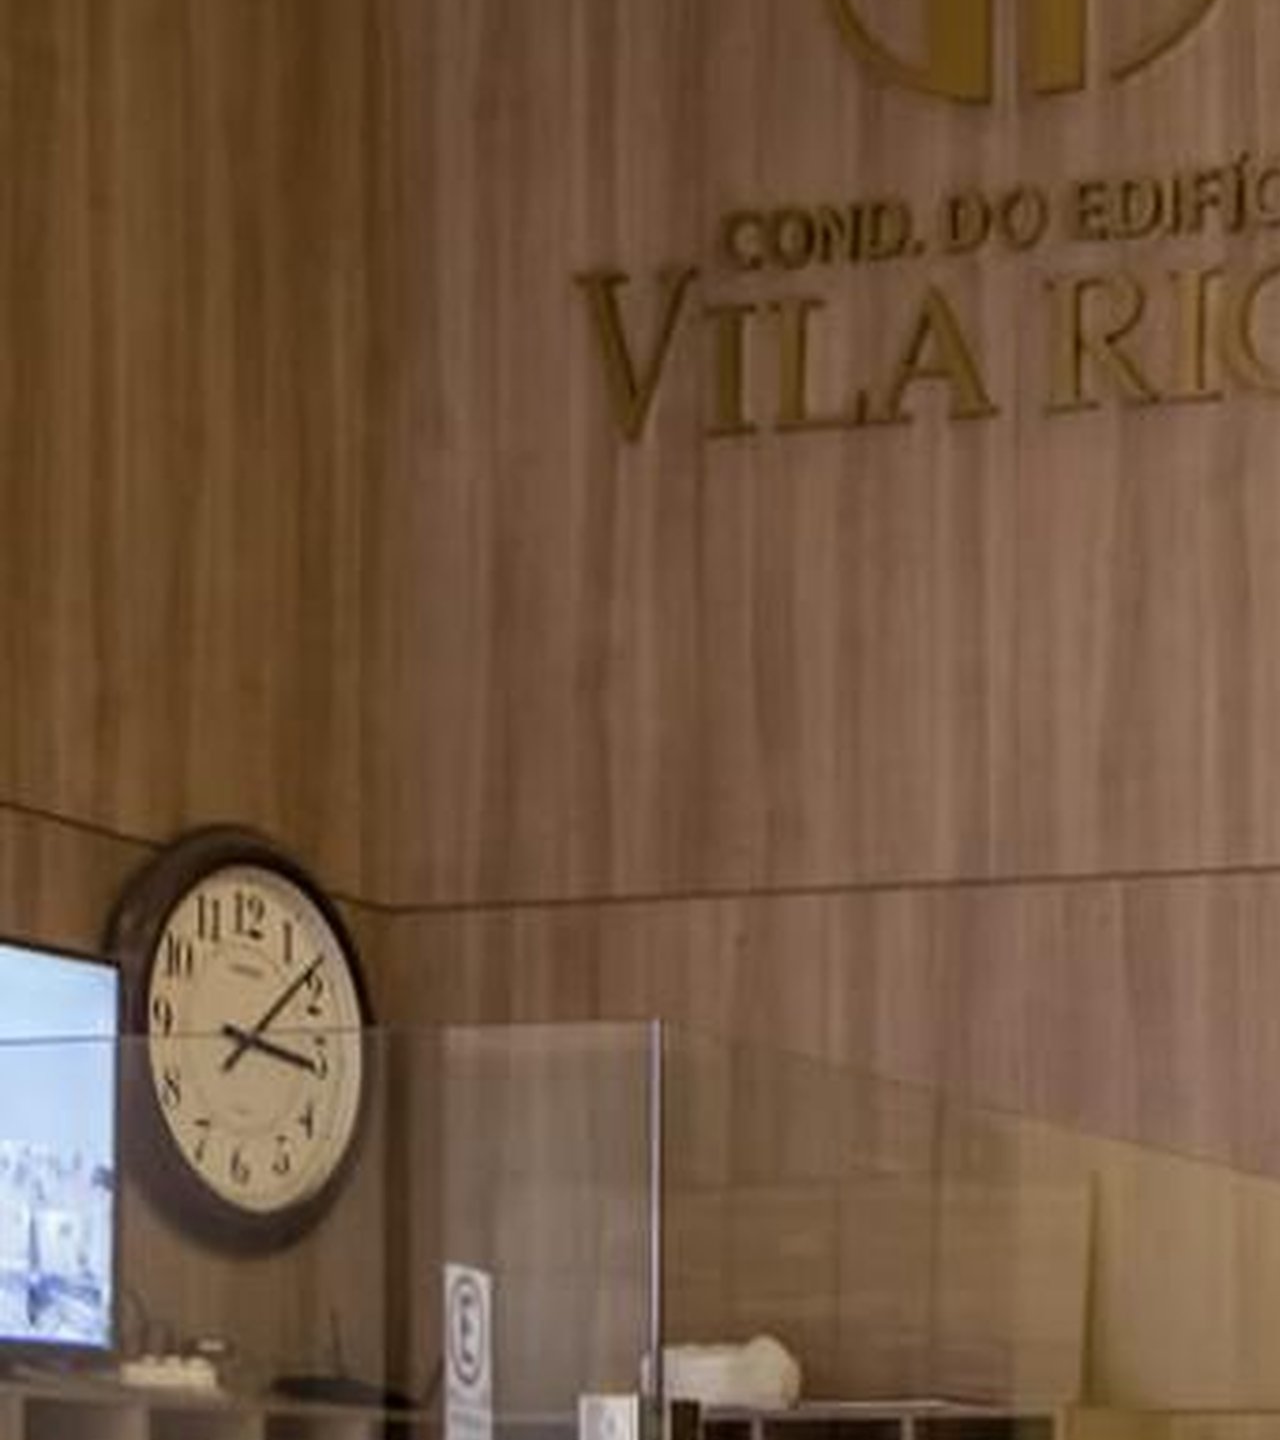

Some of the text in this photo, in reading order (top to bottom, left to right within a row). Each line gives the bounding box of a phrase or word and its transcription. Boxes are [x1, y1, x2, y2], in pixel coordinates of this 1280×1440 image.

[719, 205, 926, 272] COND.
[948, 184, 1048, 253] DO
[574, 265, 999, 448] VILA
[196, 893, 222, 944] 11
[234, 889, 266, 940] 12
[165, 930, 193, 978] 10
[283, 919, 294, 964] 1
[152, 996, 173, 1038] 9
[306, 973, 325, 1017] 2
[161, 1070, 181, 1110] 8
[194, 1118, 211, 1161] 7
[298, 1101, 314, 1140] 4
[230, 1147, 251, 1186] 6
[271, 1134, 291, 1175] 5
